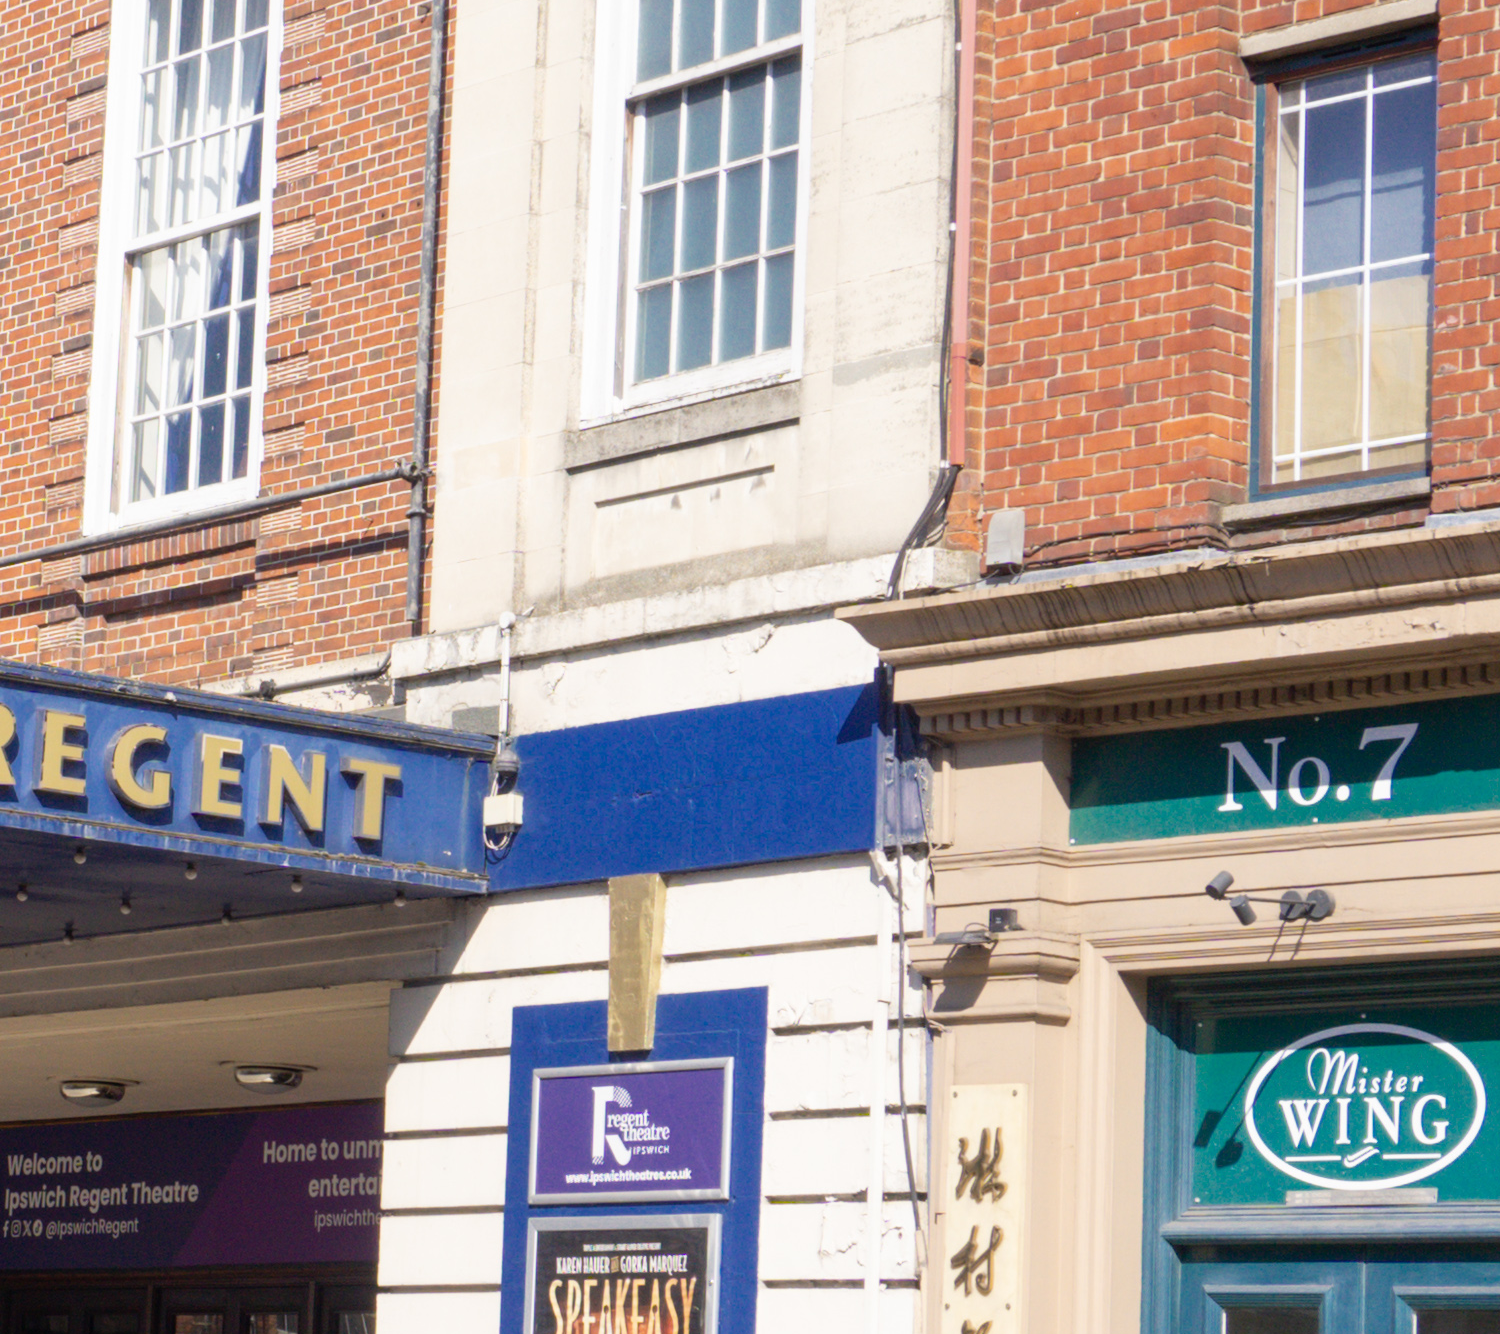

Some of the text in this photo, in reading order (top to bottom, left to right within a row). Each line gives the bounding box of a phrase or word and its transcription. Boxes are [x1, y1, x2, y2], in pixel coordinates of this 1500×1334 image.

[1307, 1047, 1424, 1095] Mister
[607, 1108, 650, 1129] regent
[1278, 1094, 1450, 1149] WING
[619, 1123, 671, 1143] theatre
[263, 1141, 317, 1164] Home
[320, 1138, 340, 1160] to
[632, 1145, 670, 1156] IPSWICH
[7, 1151, 103, 1177] Welcome to
[565, 1167, 693, 1186] www.ipswichtheatres.co.uk
[4, 1180, 200, 1215] Ipswich Regent Theatre
[45, 1217, 139, 1240] @IpswichRegent
[555, 1254, 688, 1276] KAREN HAUER GORKA MARQUEZ
